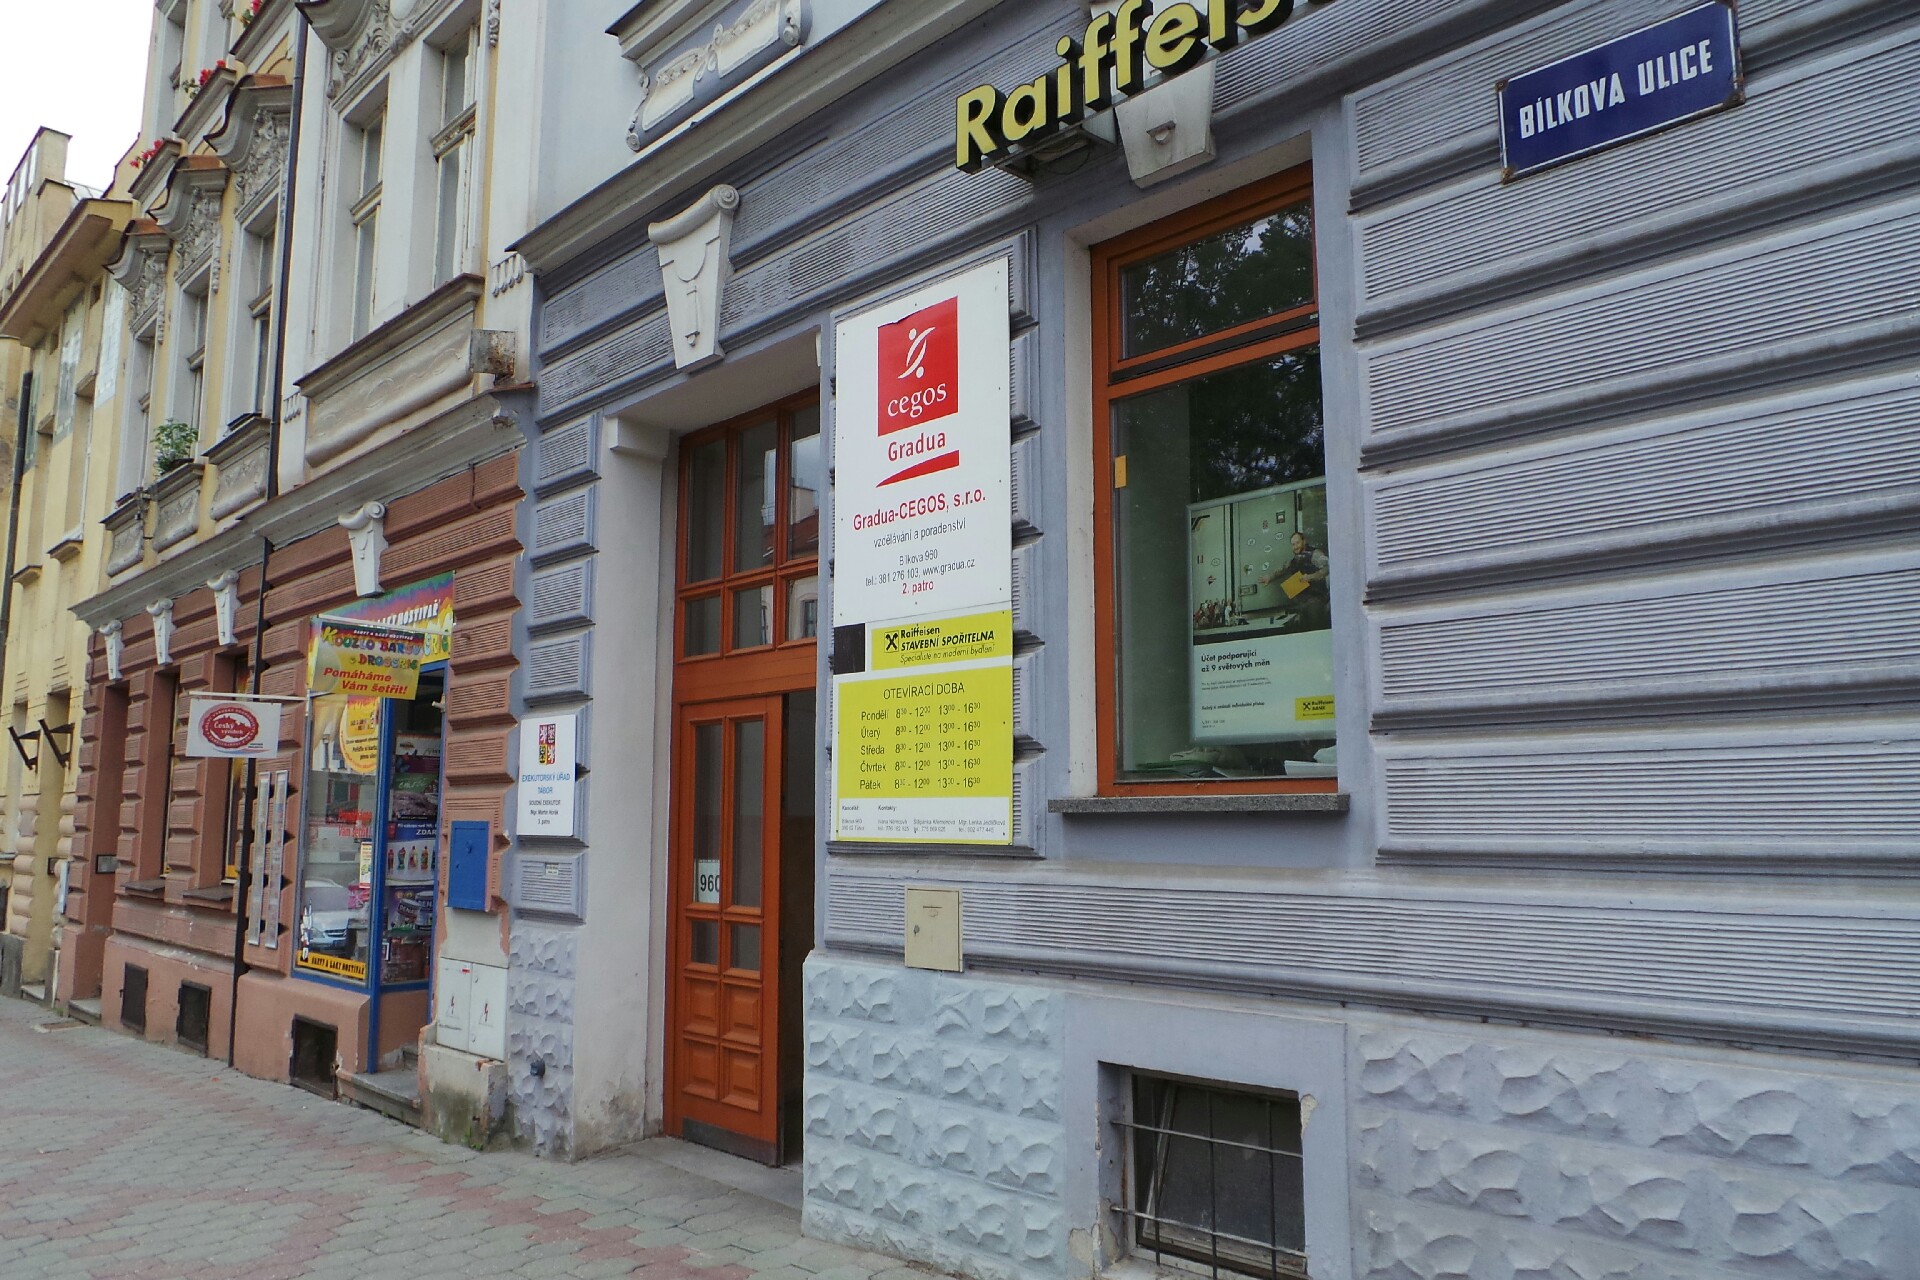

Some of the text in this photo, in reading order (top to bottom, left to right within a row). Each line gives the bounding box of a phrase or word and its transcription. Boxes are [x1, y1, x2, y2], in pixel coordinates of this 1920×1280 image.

[1519, 38, 1713, 140] BÍLKOVA ULICE
[887, 383, 947, 419] cegos
[888, 432, 946, 462] Gradua
[853, 488, 986, 531] Gradua-CEGOS, s.r.o.
[914, 530, 919, 539] a
[878, 571, 890, 585] 381
[892, 569, 905, 582] 276
[922, 557, 976, 577] www.gradua.cz
[902, 579, 934, 596] 2. patro
[900, 625, 940, 639] Raiffeisen
[900, 630, 995, 652] STAVEBNÍ SPOŘITELNA
[1201, 649, 1257, 663] Účet podporující
[1201, 658, 1271, 673] až 9 světových měn
[323, 667, 392, 682] Pomáháme
[341, 680, 408, 695] Vám šetřit!
[883, 682, 965, 701] OTEVÍRACÍ DOBA
[213, 721, 234, 730] Český
[861, 727, 881, 741] Úterý
[860, 744, 885, 756] Středa
[860, 760, 887, 773] Čtvrtek
[860, 777, 881, 790] Pátek
